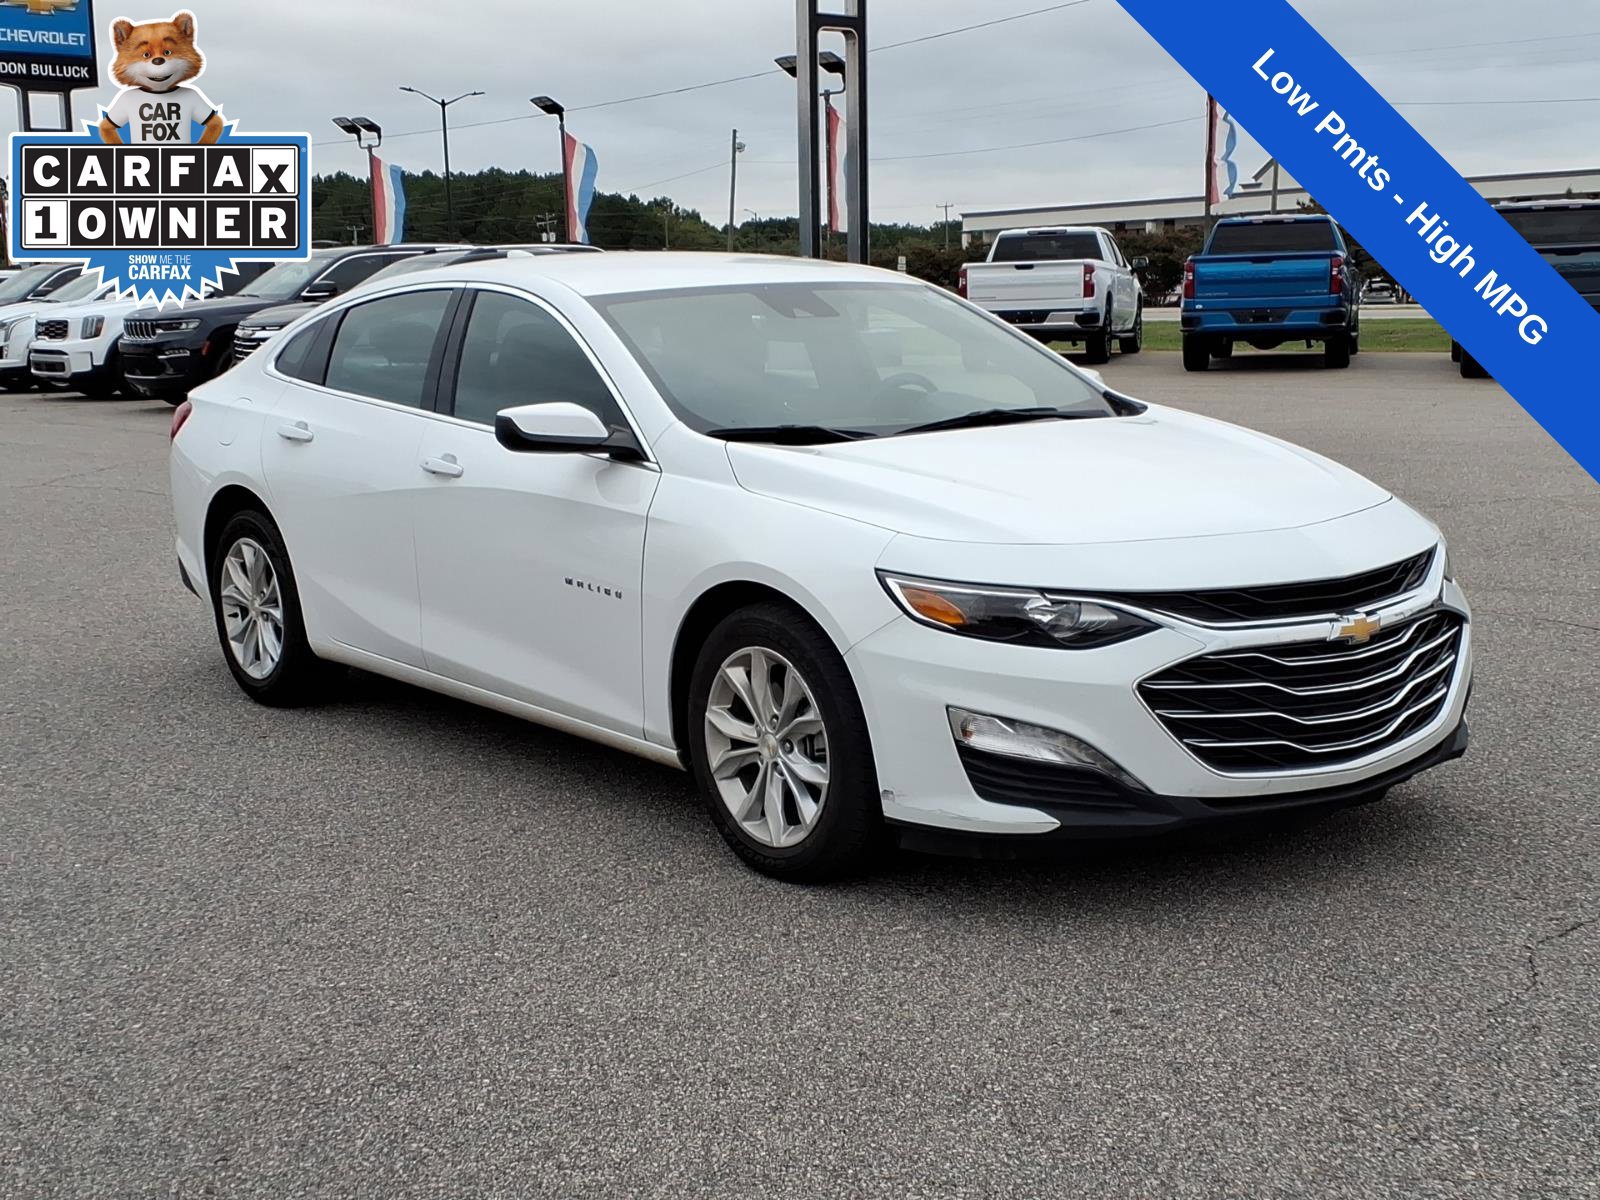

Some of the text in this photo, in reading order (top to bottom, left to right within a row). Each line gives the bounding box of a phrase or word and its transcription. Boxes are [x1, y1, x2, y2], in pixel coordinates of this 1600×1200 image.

[0, 28, 86, 46] CHEVROLET
[0, 61, 89, 79] DON BULLUCK
